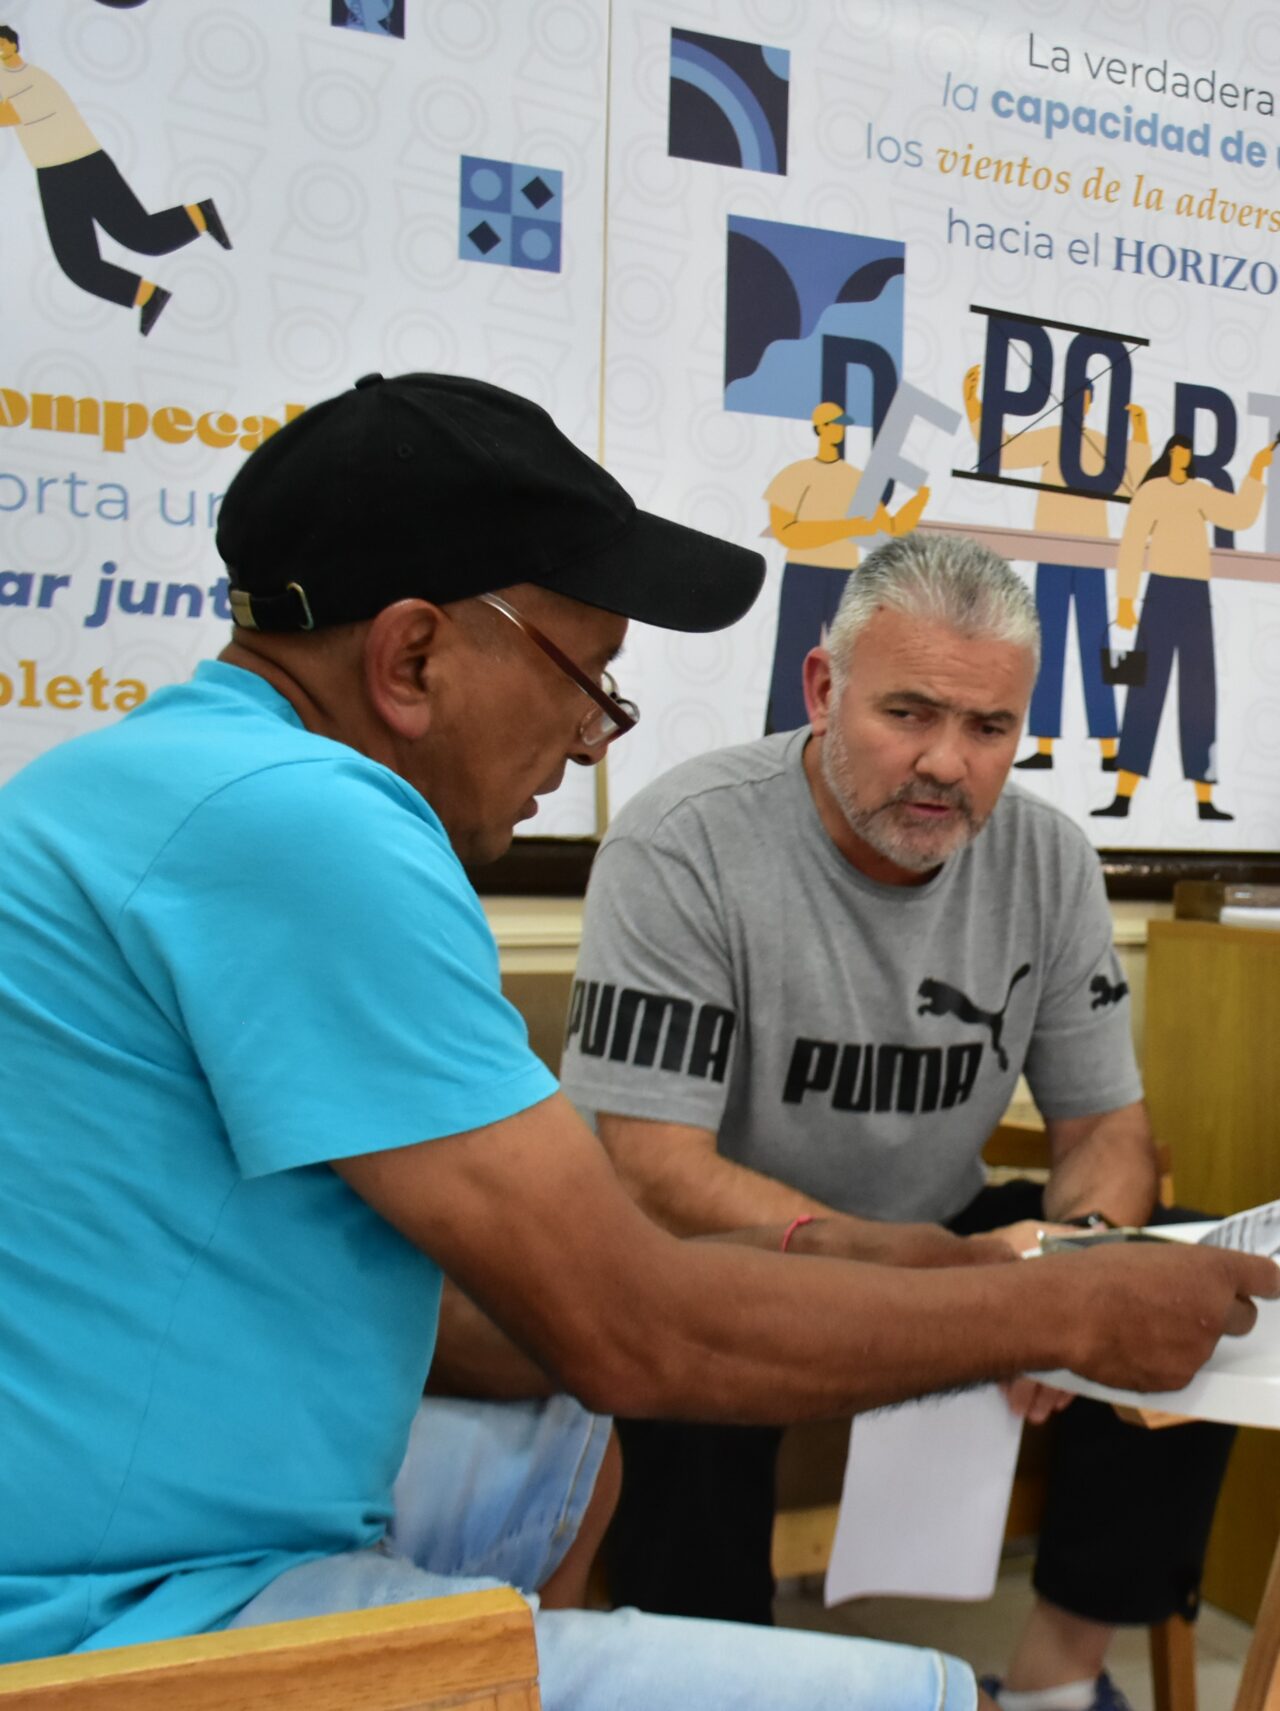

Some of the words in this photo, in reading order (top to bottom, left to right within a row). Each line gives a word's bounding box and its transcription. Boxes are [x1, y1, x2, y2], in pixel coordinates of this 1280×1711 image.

[1029, 32, 1070, 74] La
[1084, 52, 1275, 116] verdadera
[942, 71, 979, 112] la
[990, 90, 1211, 158] capacidad
[1220, 130, 1267, 168] de
[866, 122, 923, 168] los
[936, 143, 1071, 195] vientos
[1081, 167, 1121, 203] de
[1131, 174, 1164, 212] la
[947, 207, 1054, 260] hacia
[1068, 232, 1100, 267] el
[0, 387, 307, 453] ompeca
[566, 979, 737, 1084] PUMA
[781, 1037, 984, 1115] PUMA
